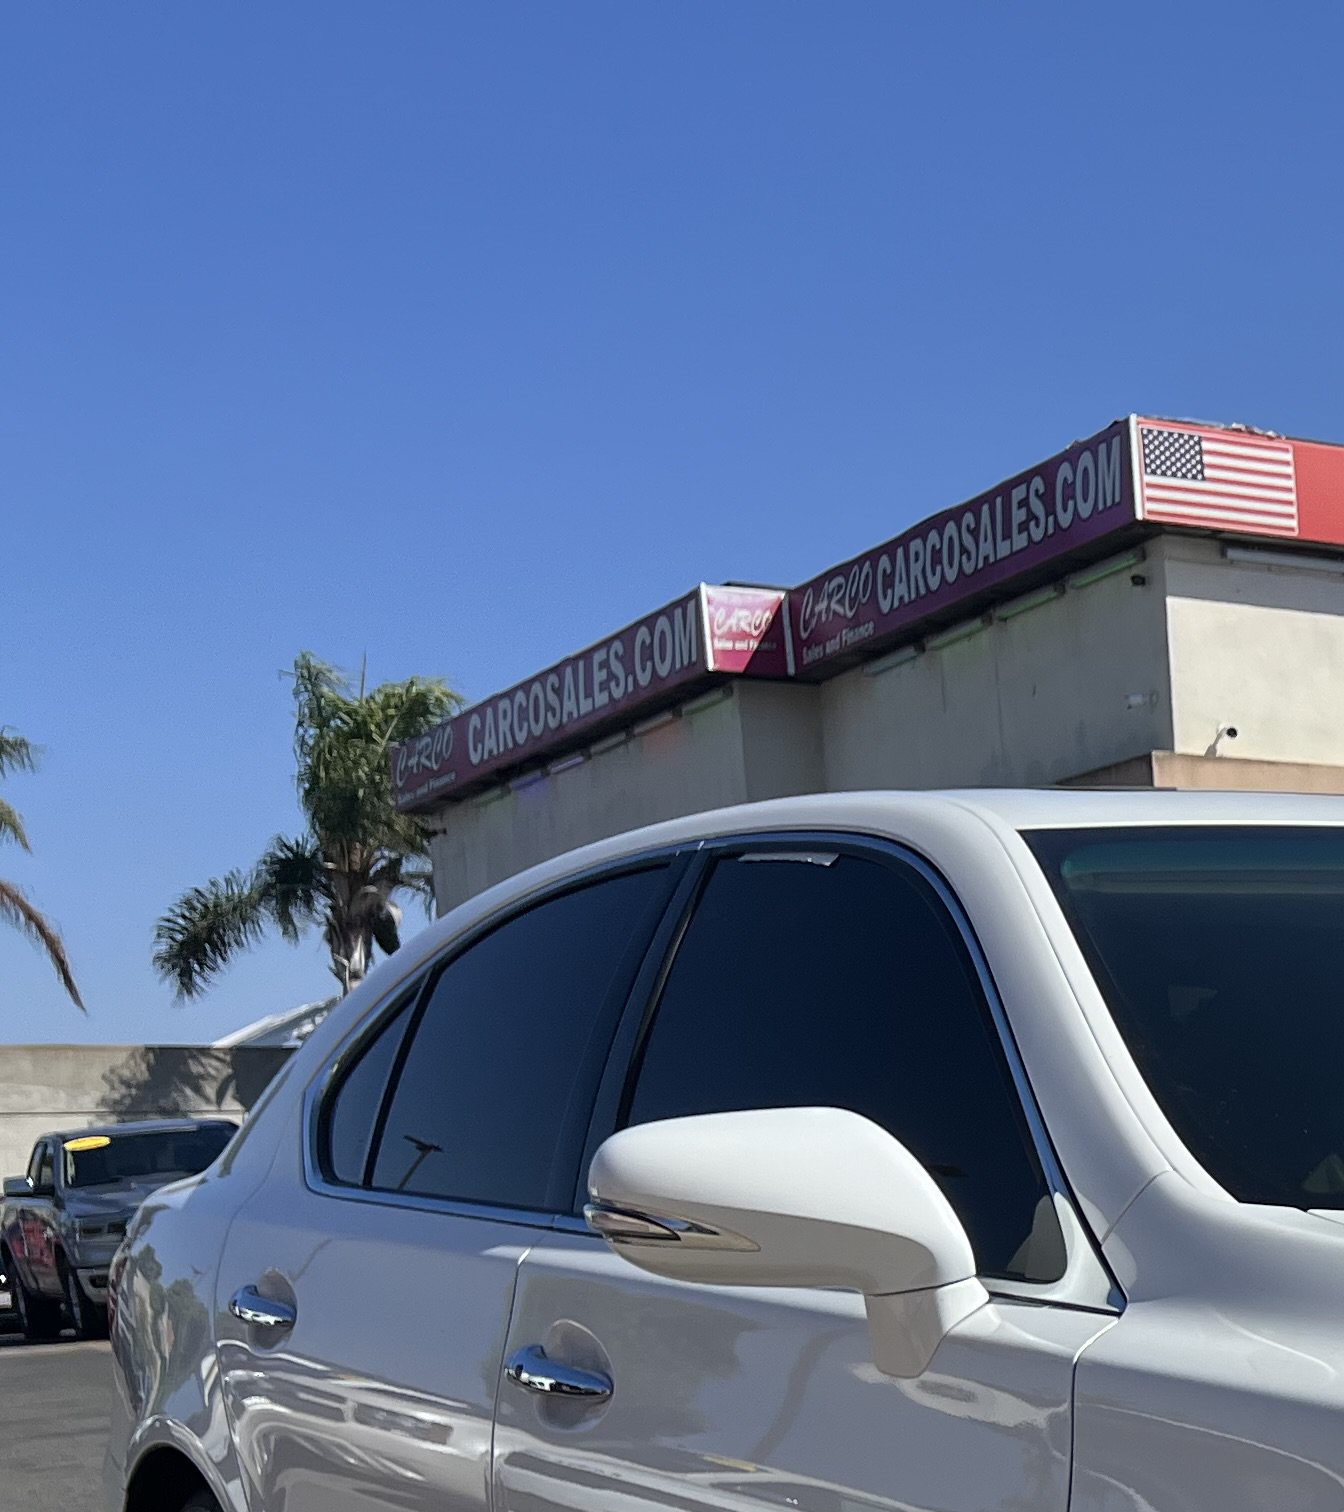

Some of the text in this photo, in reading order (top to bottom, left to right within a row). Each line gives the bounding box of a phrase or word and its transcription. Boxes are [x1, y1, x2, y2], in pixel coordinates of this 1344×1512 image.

[800, 434, 1122, 640] CARCO CARCOSALES.COM
[467, 598, 699, 767] CARCOSALES.COM
